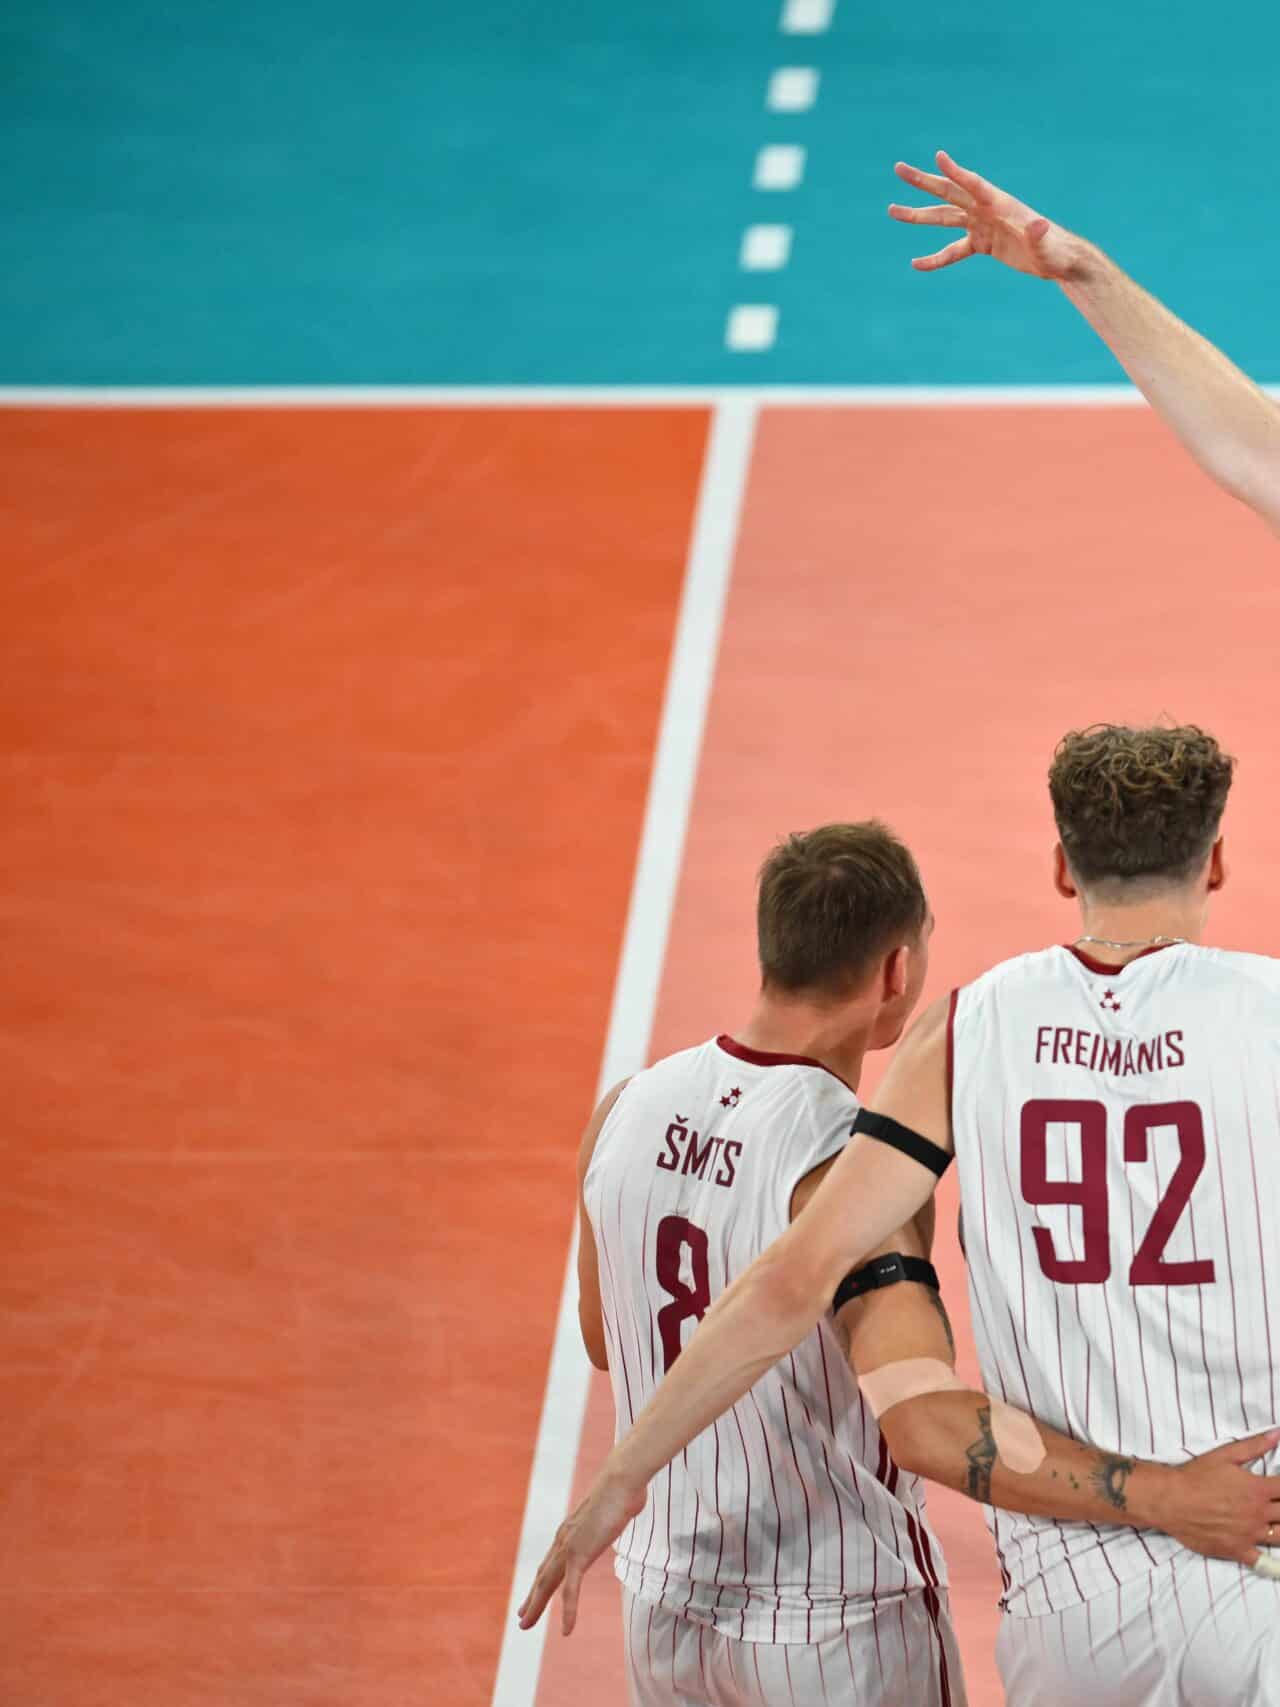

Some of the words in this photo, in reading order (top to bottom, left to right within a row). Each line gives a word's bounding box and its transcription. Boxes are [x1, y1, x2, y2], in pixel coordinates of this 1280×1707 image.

[1036, 1026, 1185, 1076] FREIMANIS
[656, 1114, 743, 1188] ŠMTS
[1020, 1099, 1216, 1286] 92
